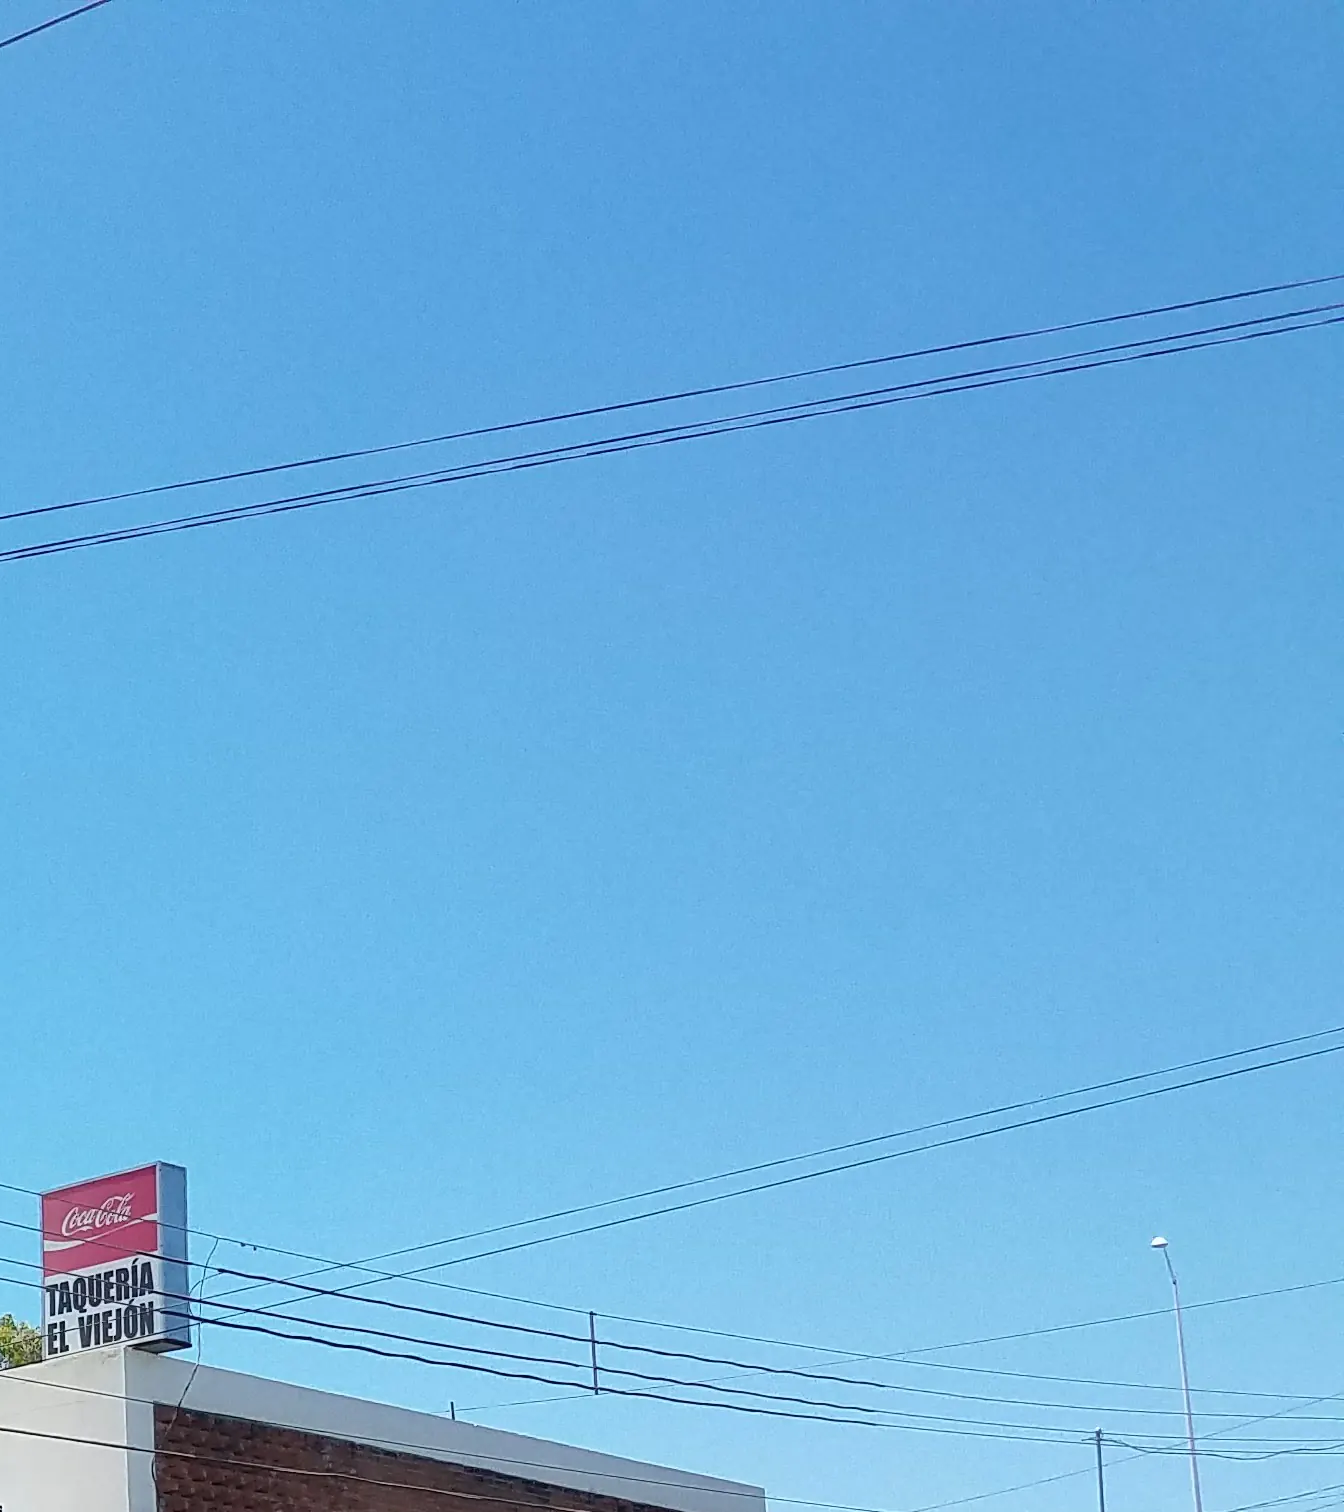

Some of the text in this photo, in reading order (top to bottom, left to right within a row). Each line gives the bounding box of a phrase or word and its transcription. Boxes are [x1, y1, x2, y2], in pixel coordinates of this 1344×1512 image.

[61, 1192, 135, 1236] Coca-Cola
[45, 1257, 154, 1317] TAQUERÍA
[47, 1298, 155, 1356] EL VIEJÓN
